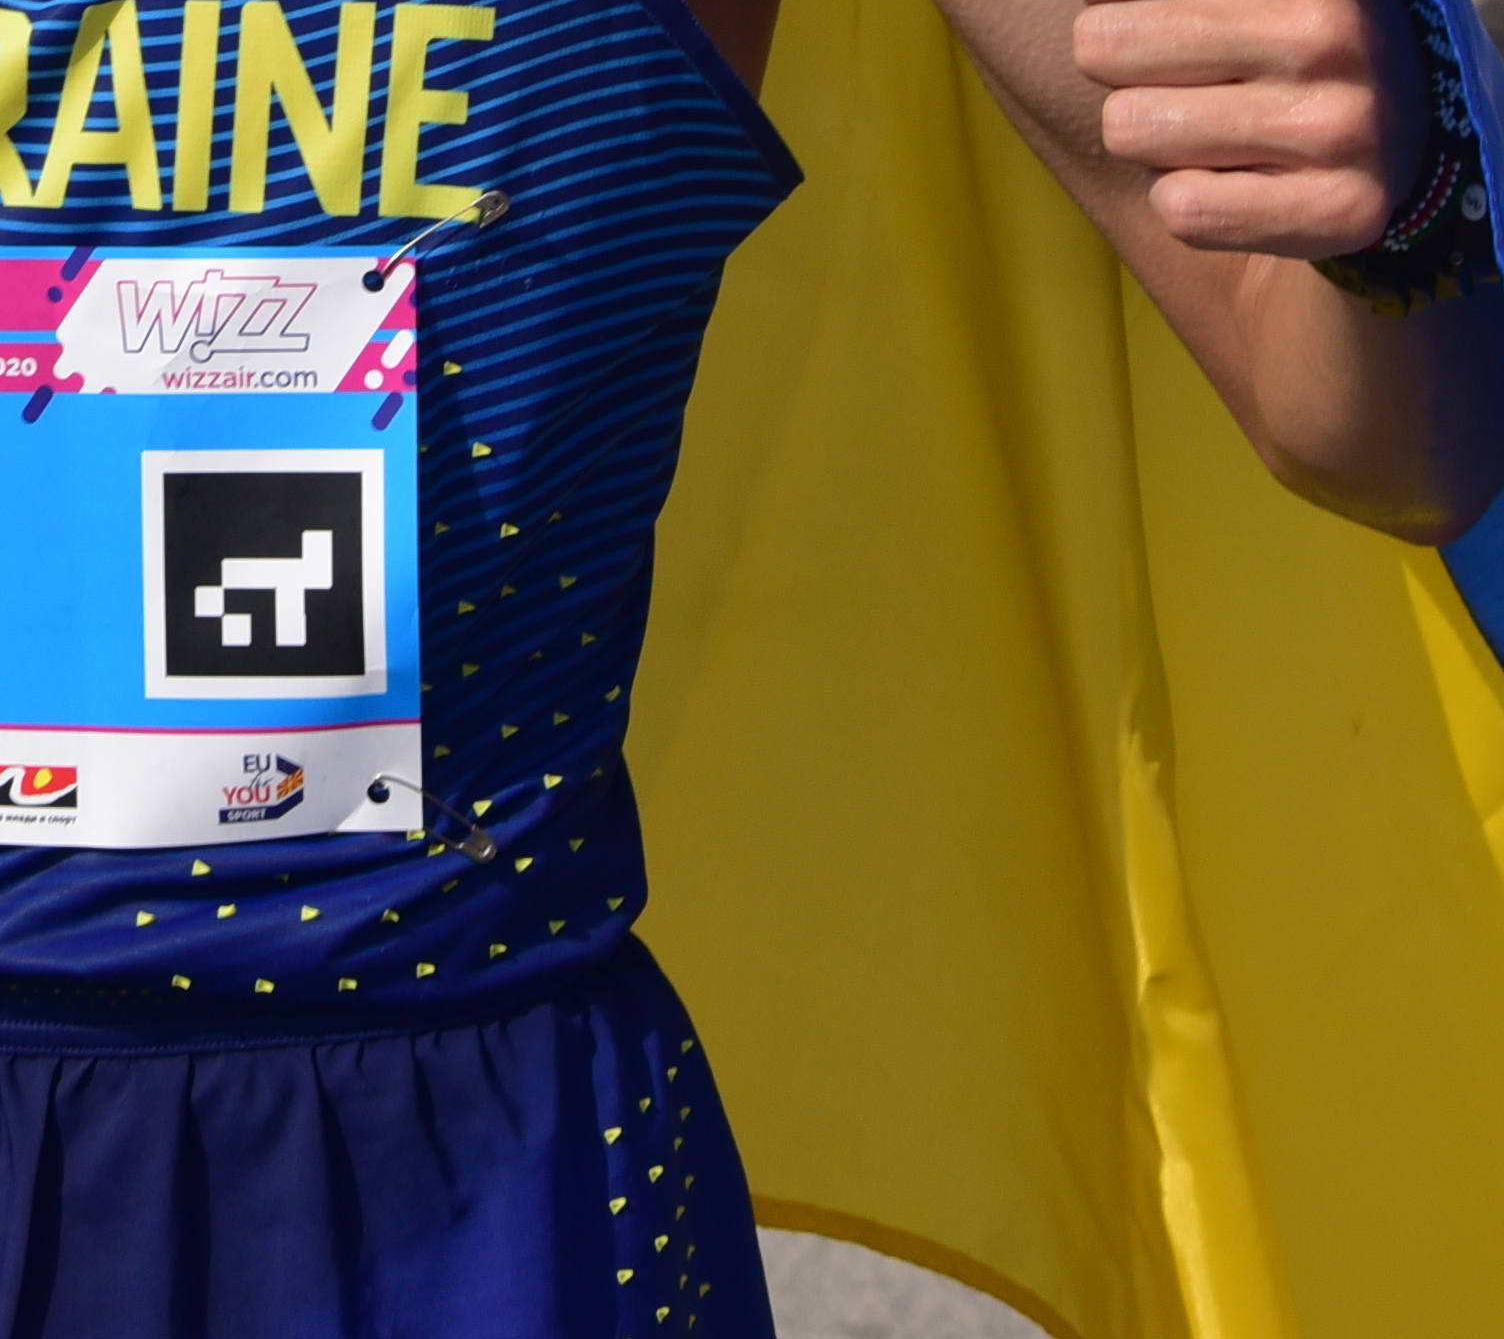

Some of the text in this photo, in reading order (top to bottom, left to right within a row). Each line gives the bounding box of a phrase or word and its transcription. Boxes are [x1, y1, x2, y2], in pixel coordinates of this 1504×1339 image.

[162, 366, 318, 389] wizzair.com
[243, 754, 271, 773] EU
[223, 785, 270, 805] YOU
[227, 808, 267, 821] SPORT
